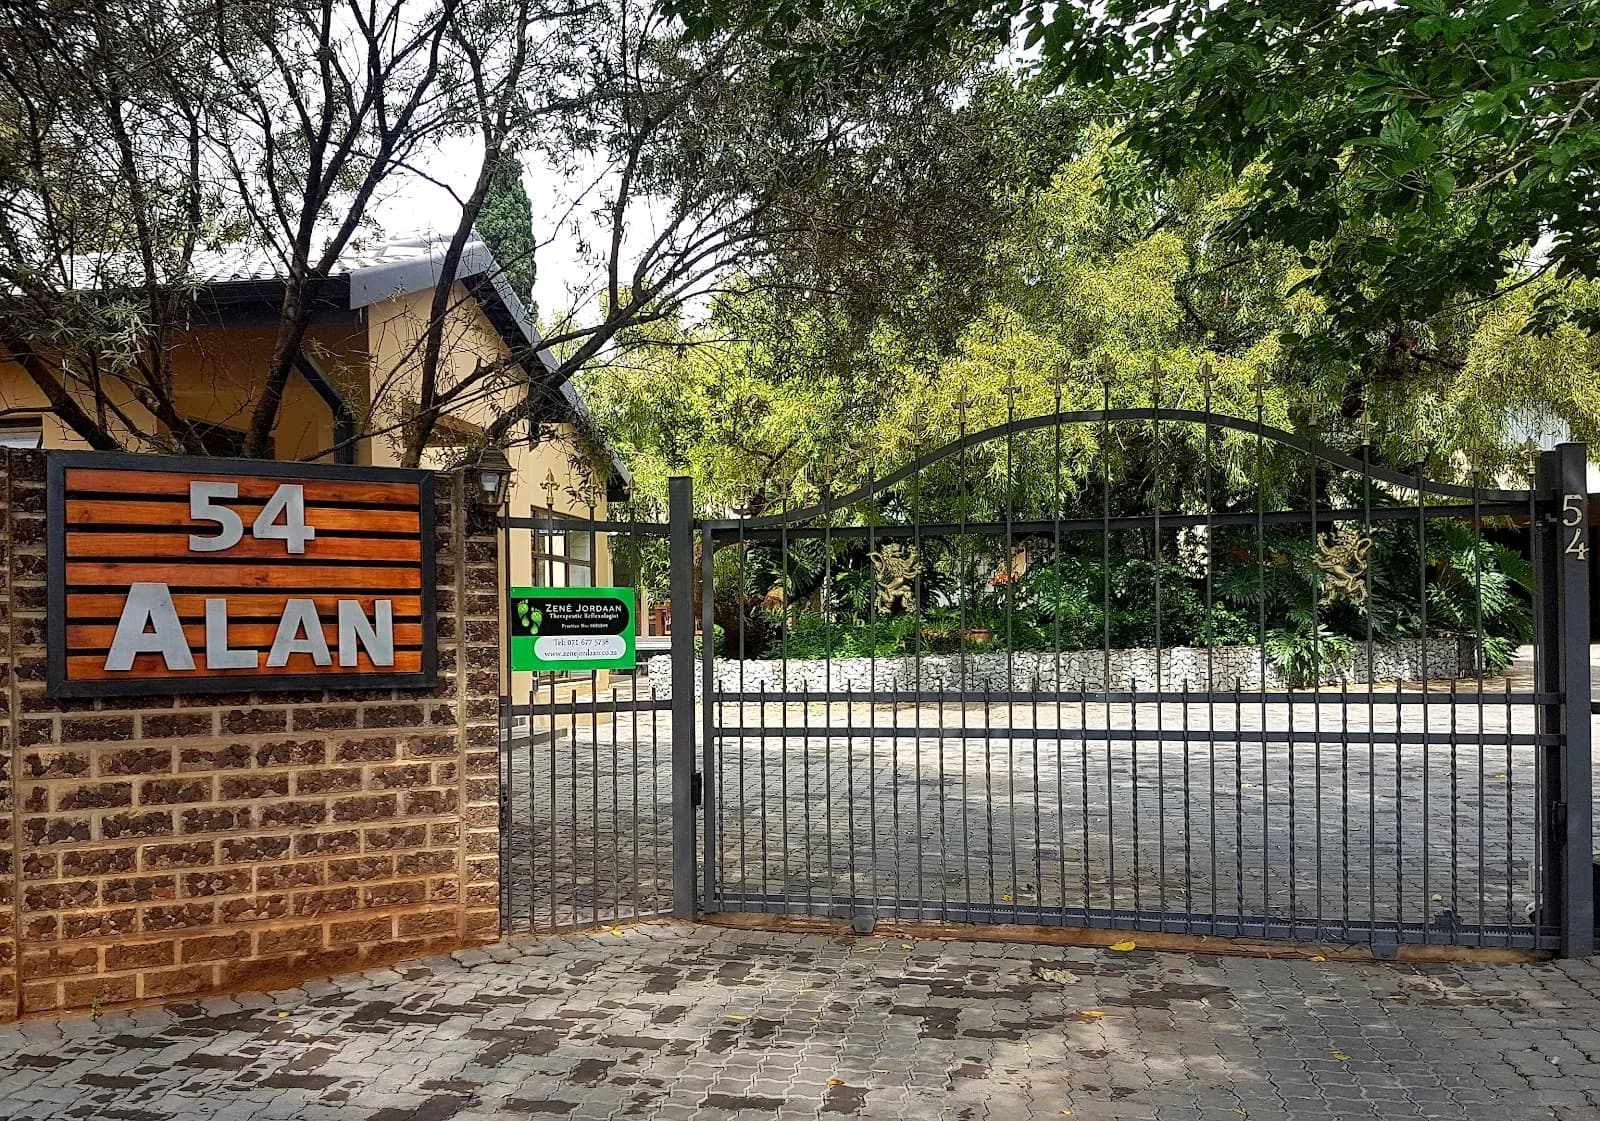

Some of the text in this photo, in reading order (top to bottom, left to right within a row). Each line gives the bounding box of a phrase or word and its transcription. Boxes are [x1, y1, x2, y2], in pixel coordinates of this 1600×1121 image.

[189, 481, 315, 554] 54
[1562, 494, 1590, 560] 54
[104, 582, 394, 670] ALAN
[575, 604, 622, 612] JORDAAN
